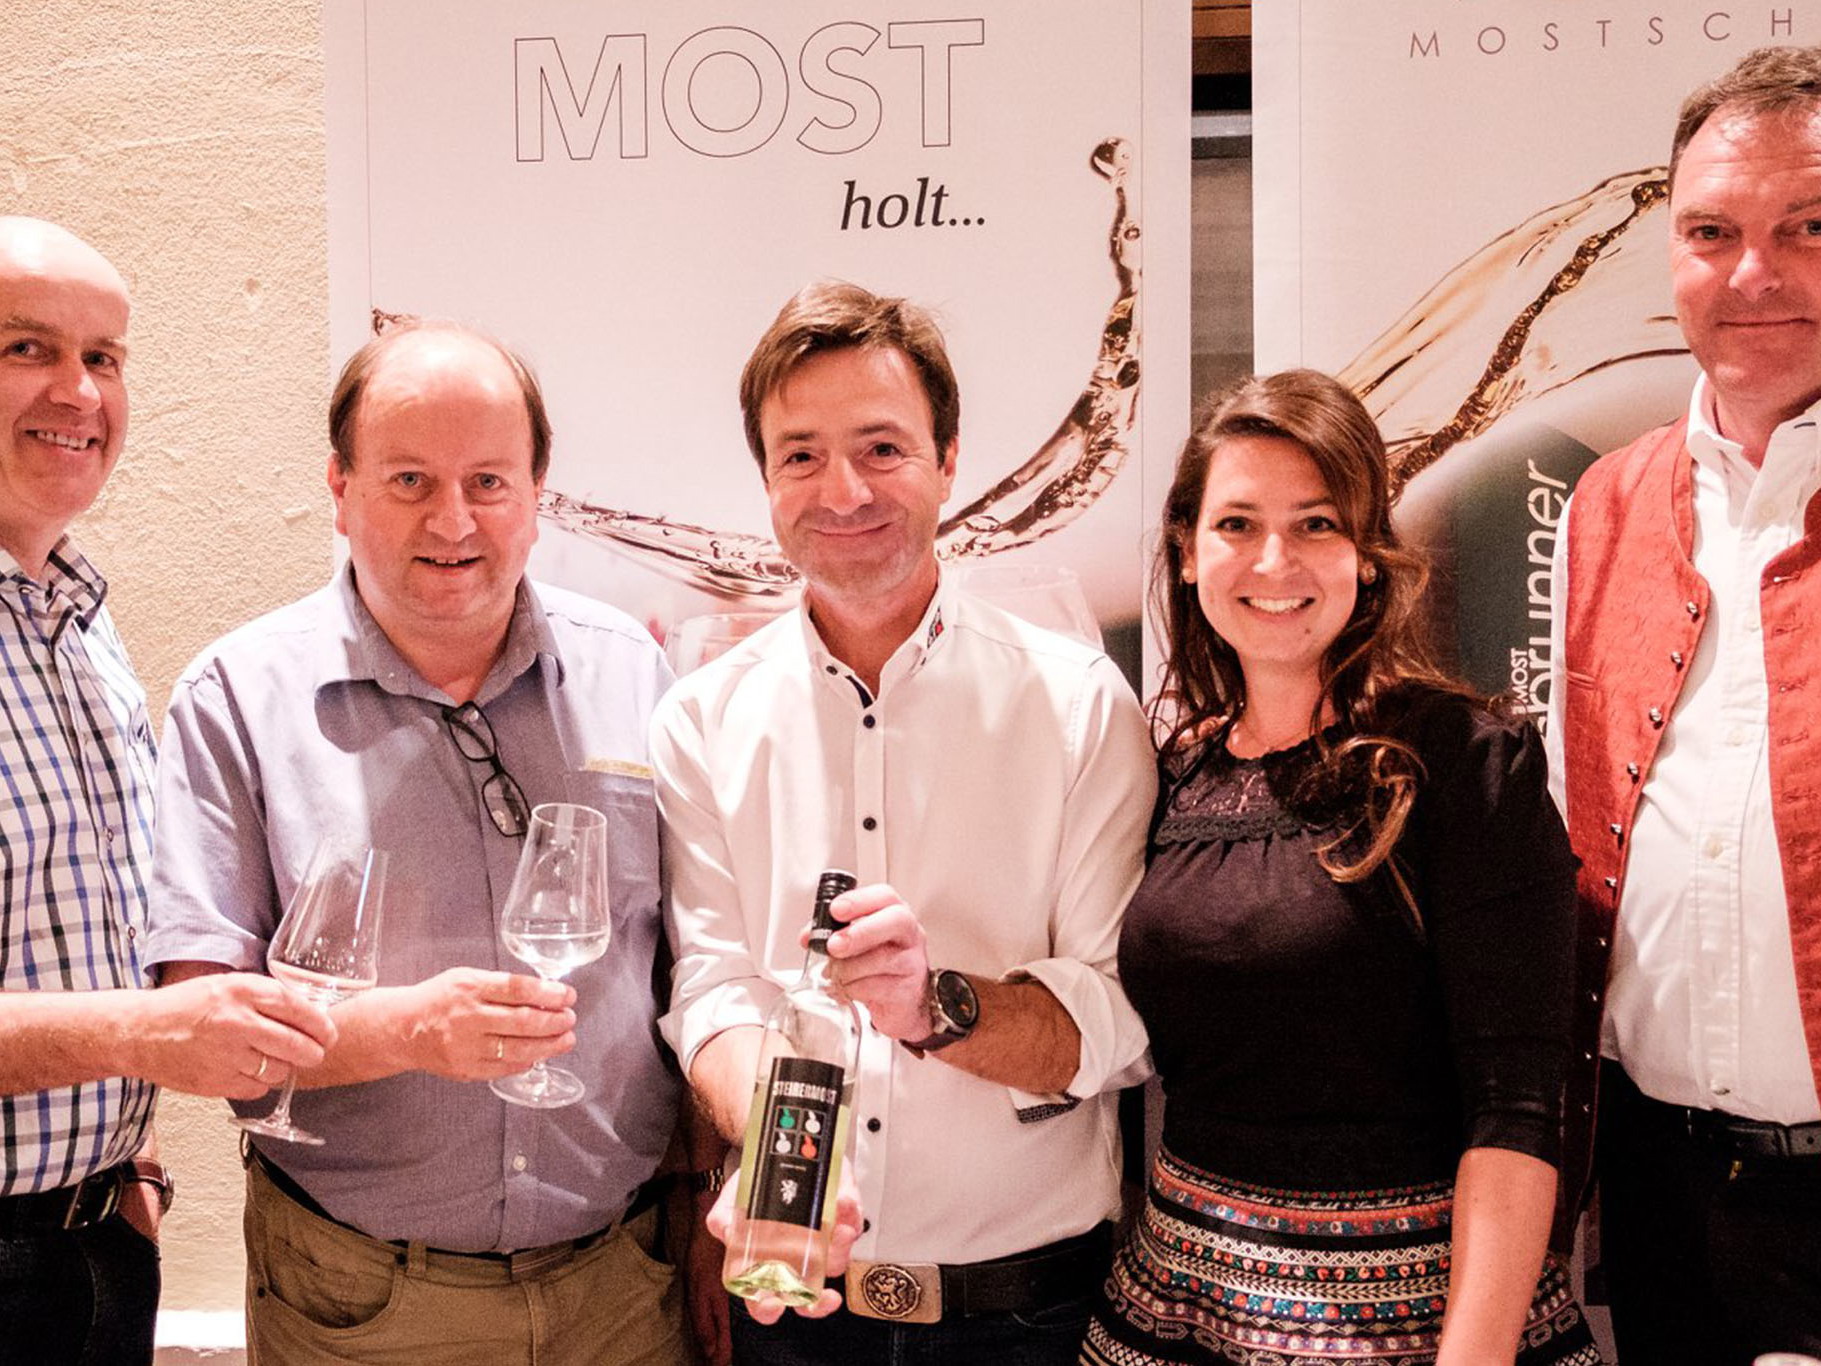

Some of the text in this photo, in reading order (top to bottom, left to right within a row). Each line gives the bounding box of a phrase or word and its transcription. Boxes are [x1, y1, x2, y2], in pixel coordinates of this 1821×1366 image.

[1409, 8, 1793, 59] MOSTSCH
[514, 18, 985, 162] MOST
[840, 176, 986, 231] holt...
[1510, 647, 1529, 704] MOST
